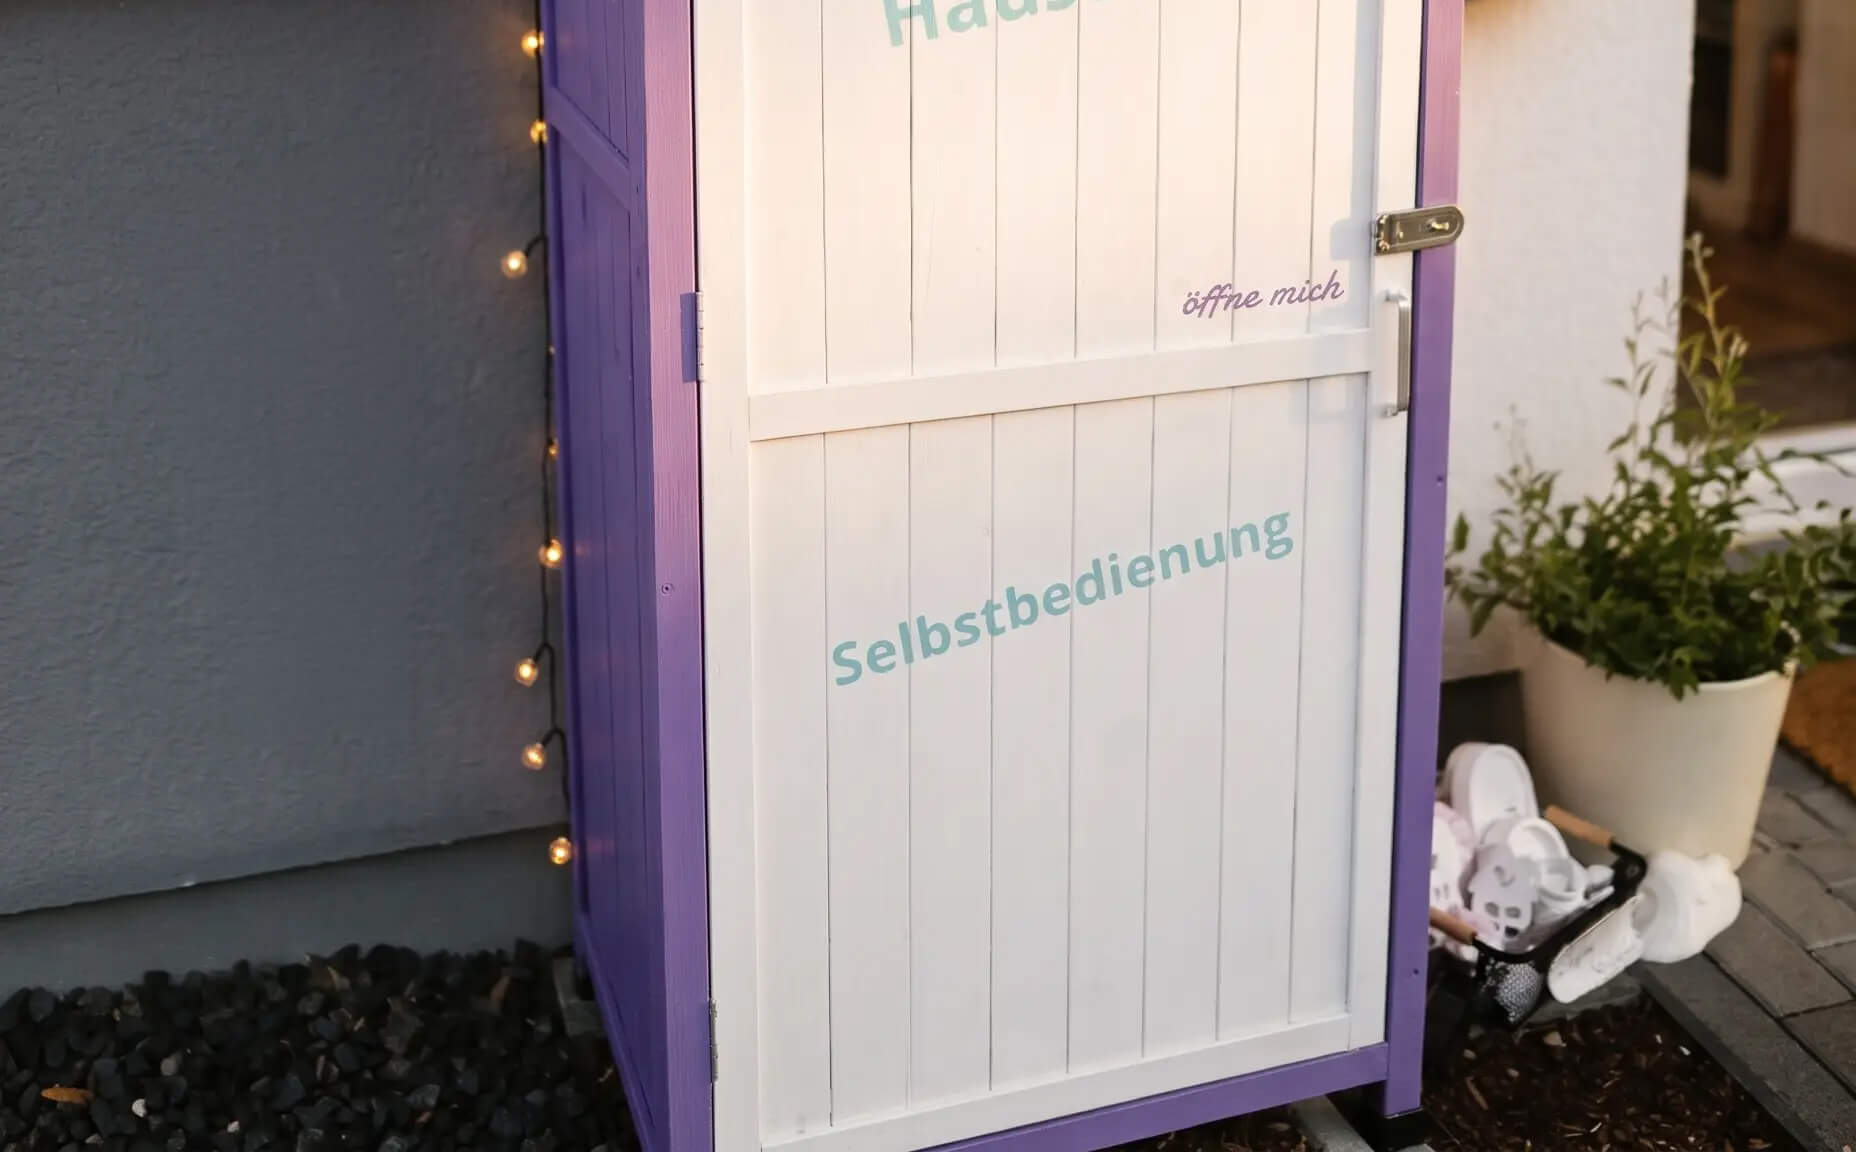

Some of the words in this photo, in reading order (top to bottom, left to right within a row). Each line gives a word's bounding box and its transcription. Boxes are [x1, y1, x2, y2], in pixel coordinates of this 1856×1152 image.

[1182, 283, 1264, 319] öffne
[1269, 269, 1345, 307] mich
[832, 510, 1295, 687] Selbstbedienung
